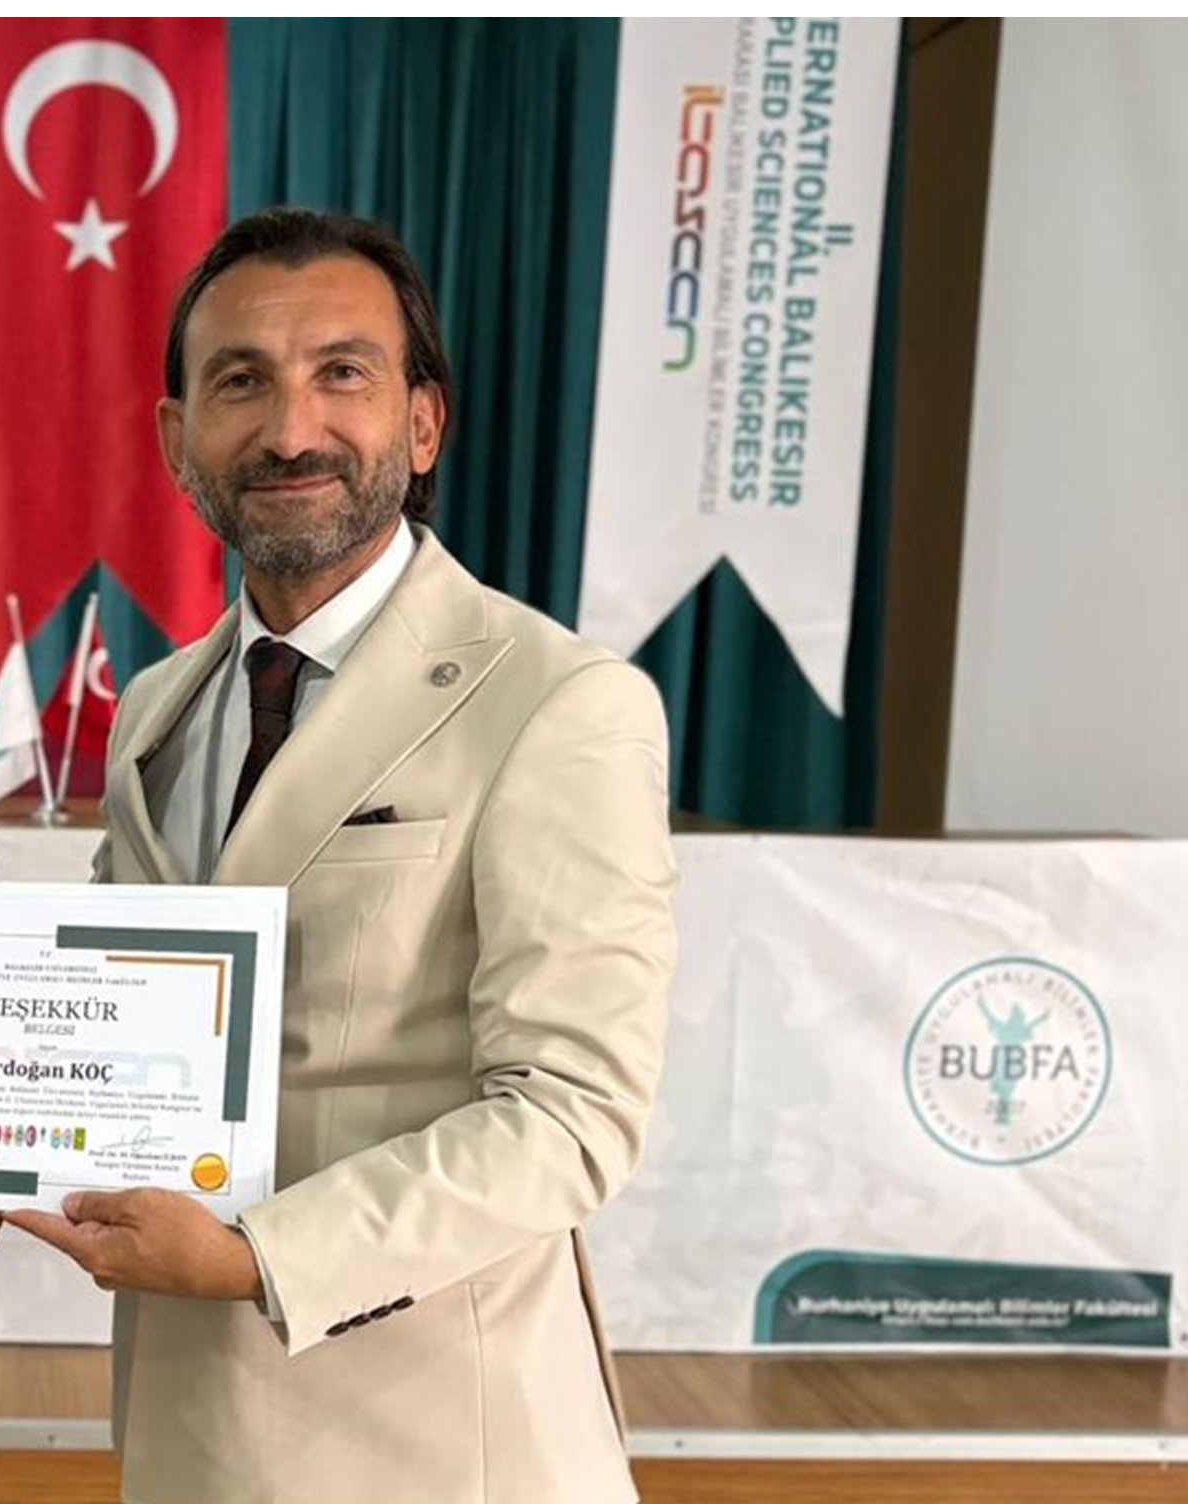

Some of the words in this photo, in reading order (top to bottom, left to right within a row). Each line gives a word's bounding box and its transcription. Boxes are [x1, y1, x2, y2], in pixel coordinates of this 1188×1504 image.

[746, 130, 787, 304] SCIENCES
[786, 17, 839, 287] ERNATIONAL
[730, 313, 771, 503] CONGRESS
[770, 298, 816, 507] BALIKESIR
[70, 1062, 114, 1083] KOÇ
[939, 1043, 1081, 1081] BUBFA
